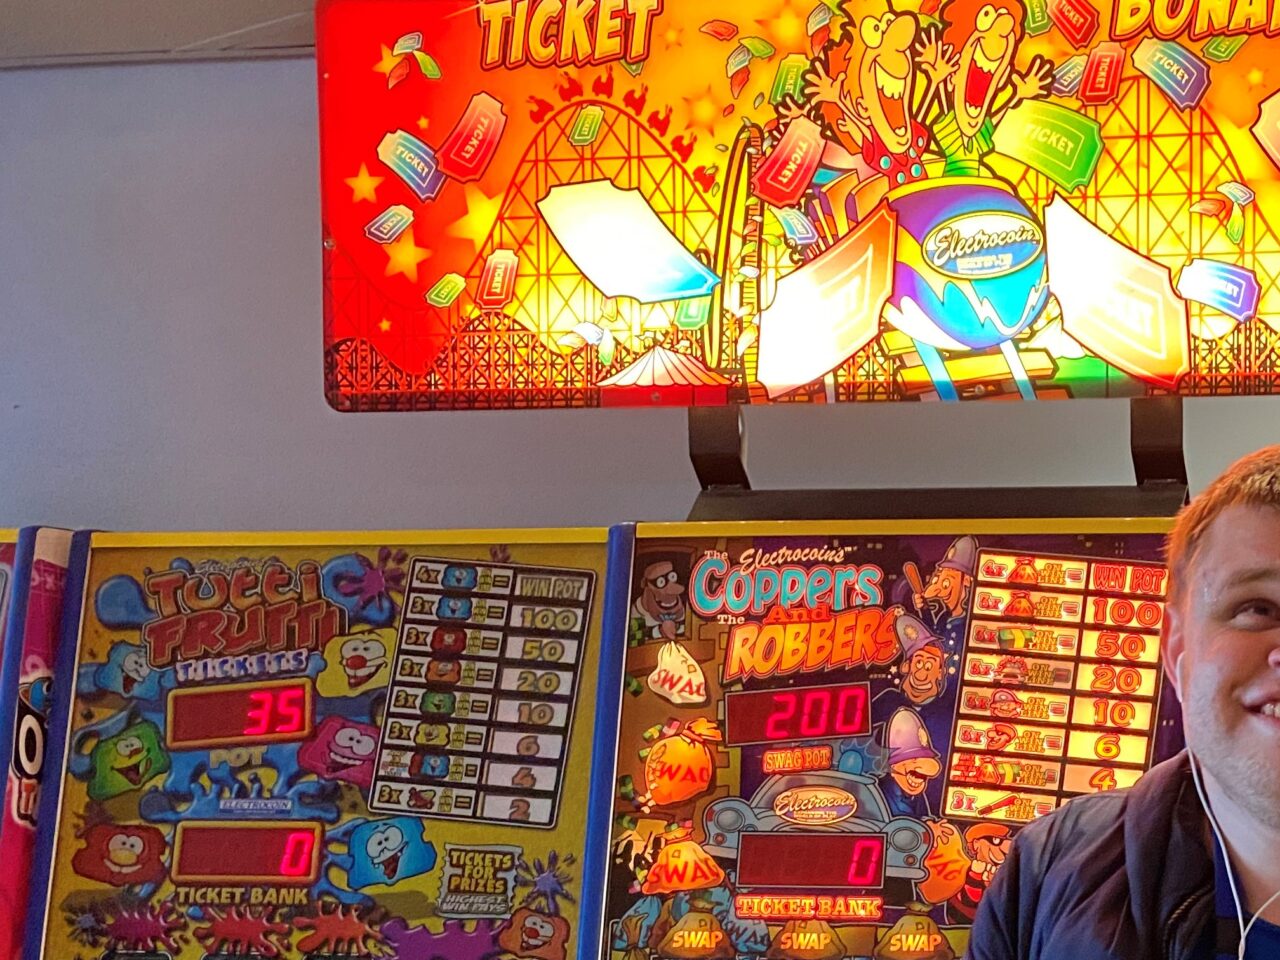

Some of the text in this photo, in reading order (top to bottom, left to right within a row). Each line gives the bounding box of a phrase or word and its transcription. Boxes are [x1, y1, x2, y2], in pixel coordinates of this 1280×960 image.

[479, 0, 664, 70] TICKET
[1095, 55, 1110, 88] TICKET
[1153, 51, 1189, 84] TICKET
[461, 115, 489, 159] TICKET
[1024, 123, 1074, 156] TICKET
[395, 145, 429, 176] TICKET
[778, 140, 808, 183] TICKET
[520, 577, 584, 600] WIN POT
[690, 555, 884, 617] Coppers
[1093, 564, 1166, 594] WIN POT
[521, 607, 578, 632] 100
[717, 614, 745, 625] The
[763, 603, 832, 624] And
[1093, 598, 1163, 628] 100
[144, 600, 342, 667] FRUTTI
[724, 606, 901, 684] ROBBERS
[1096, 631, 1146, 660] 50
[522, 639, 566, 662] 50
[176, 649, 309, 683] TICKETS
[1090, 664, 1142, 694] 20
[517, 671, 561, 694] 20
[244, 688, 304, 735] 35
[518, 702, 555, 725] 10
[765, 688, 866, 740] 200
[1092, 698, 1137, 728] 10
[209, 747, 268, 769] POT
[516, 735, 540, 757] 6
[765, 749, 830, 771] SWAG POT
[1094, 733, 1121, 760] 6
[1089, 767, 1118, 791] 4
[279, 832, 314, 876] 0
[449, 849, 513, 872] TICKETS
[847, 839, 882, 886] 0
[449, 875, 506, 894] PRIZES
[464, 864, 495, 880] FOR
[177, 887, 308, 906] TICKET BANK
[736, 896, 882, 919] TICKET BANK
[672, 931, 723, 949] SWAP
[780, 931, 832, 950] SWAP
[890, 934, 942, 953] SWAP
